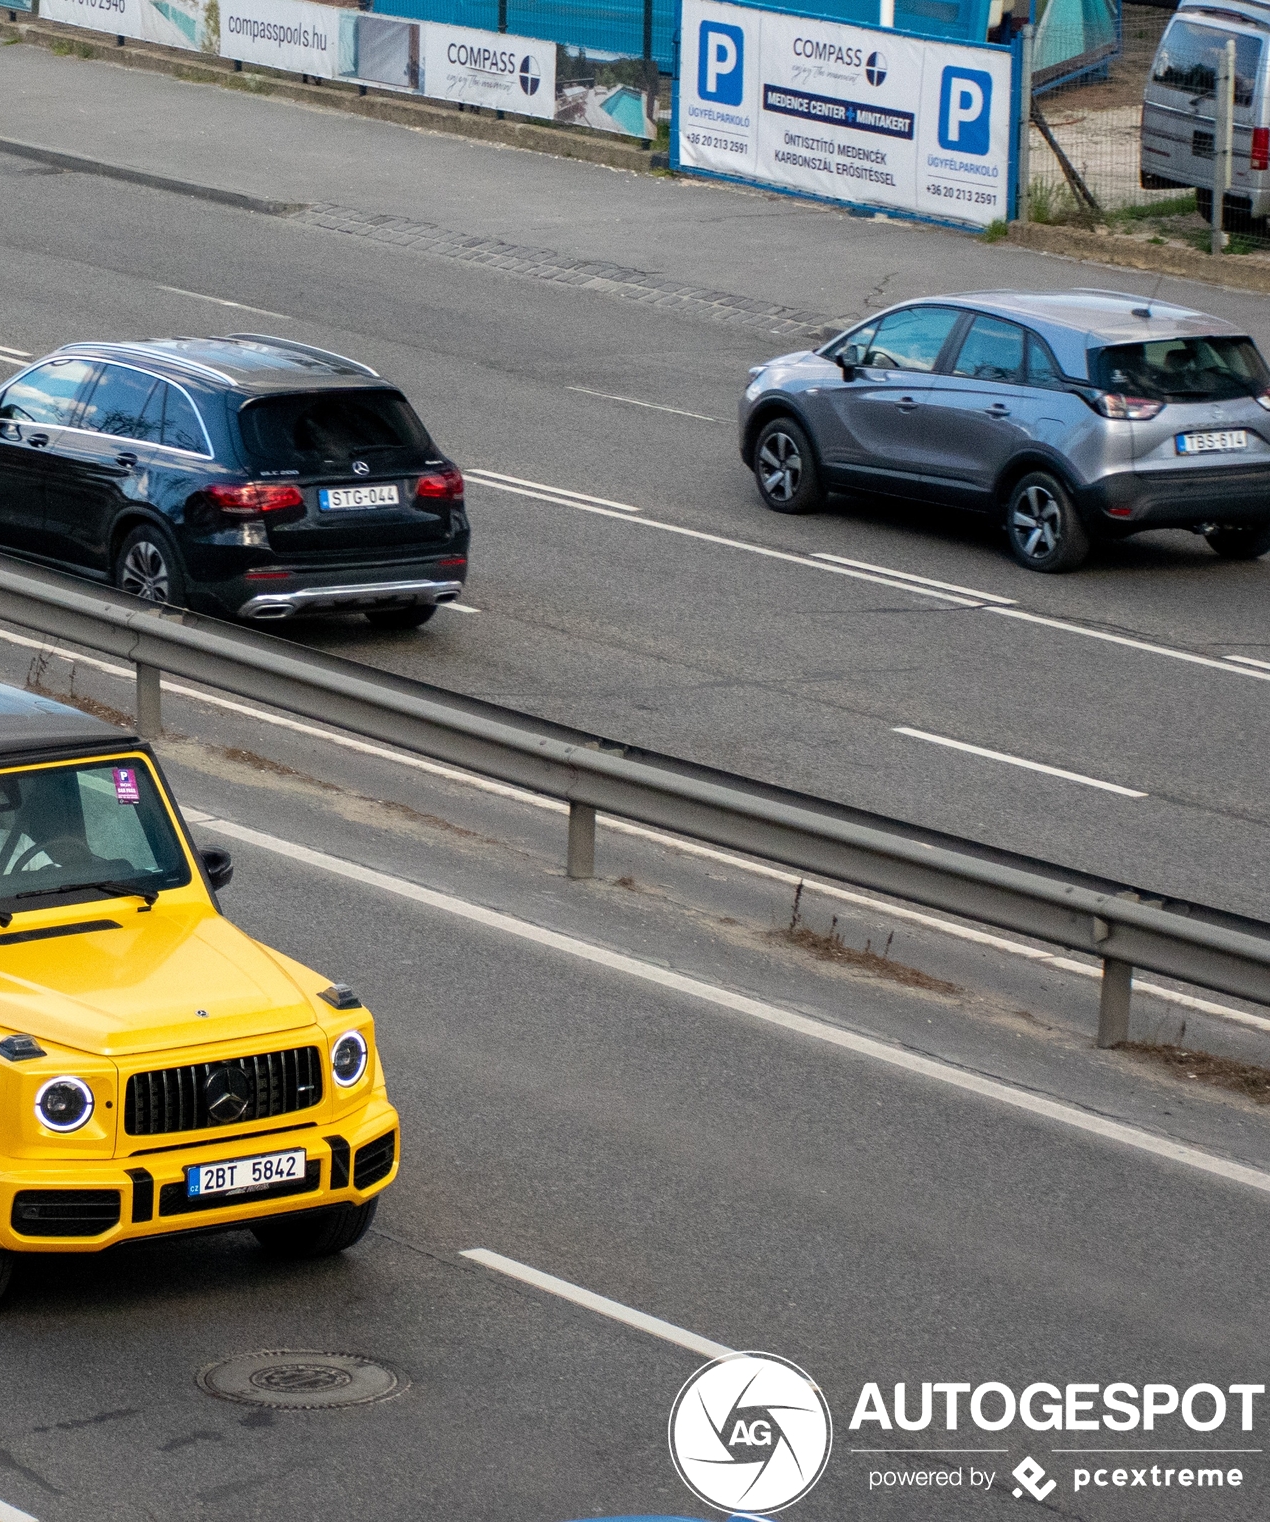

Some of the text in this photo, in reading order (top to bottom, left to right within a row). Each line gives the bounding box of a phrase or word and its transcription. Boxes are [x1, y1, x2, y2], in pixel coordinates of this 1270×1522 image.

[228, 15, 327, 51] compasspools.hu
[447, 43, 516, 74] COMPASS
[706, 31, 737, 93] P
[793, 37, 863, 67] COMPASS
[688, 105, 750, 128] ÜGYFÉLPARKOLÓ
[767, 91, 810, 113] MEDENCE
[810, 101, 846, 120] CENTER
[856, 109, 911, 133] MINTAKERT
[947, 77, 984, 142] P
[686, 132, 748, 155] +36 20 213 2591
[784, 129, 888, 166] ÖNTISZTÍTÓ MEDENCÉK
[774, 149, 897, 187] KARBONSZÁL ERŐSÍTÉSSEL
[927, 153, 999, 178] ÜGYFÉLPARKOLÓ
[926, 184, 998, 207] +36 20 213 2591
[1187, 432, 1243, 450] TBS-614
[332, 487, 395, 507] STG-044
[189, 1184, 199, 1192] CZ
[204, 1165, 238, 1191] 2BT
[251, 1156, 297, 1182] 5842
